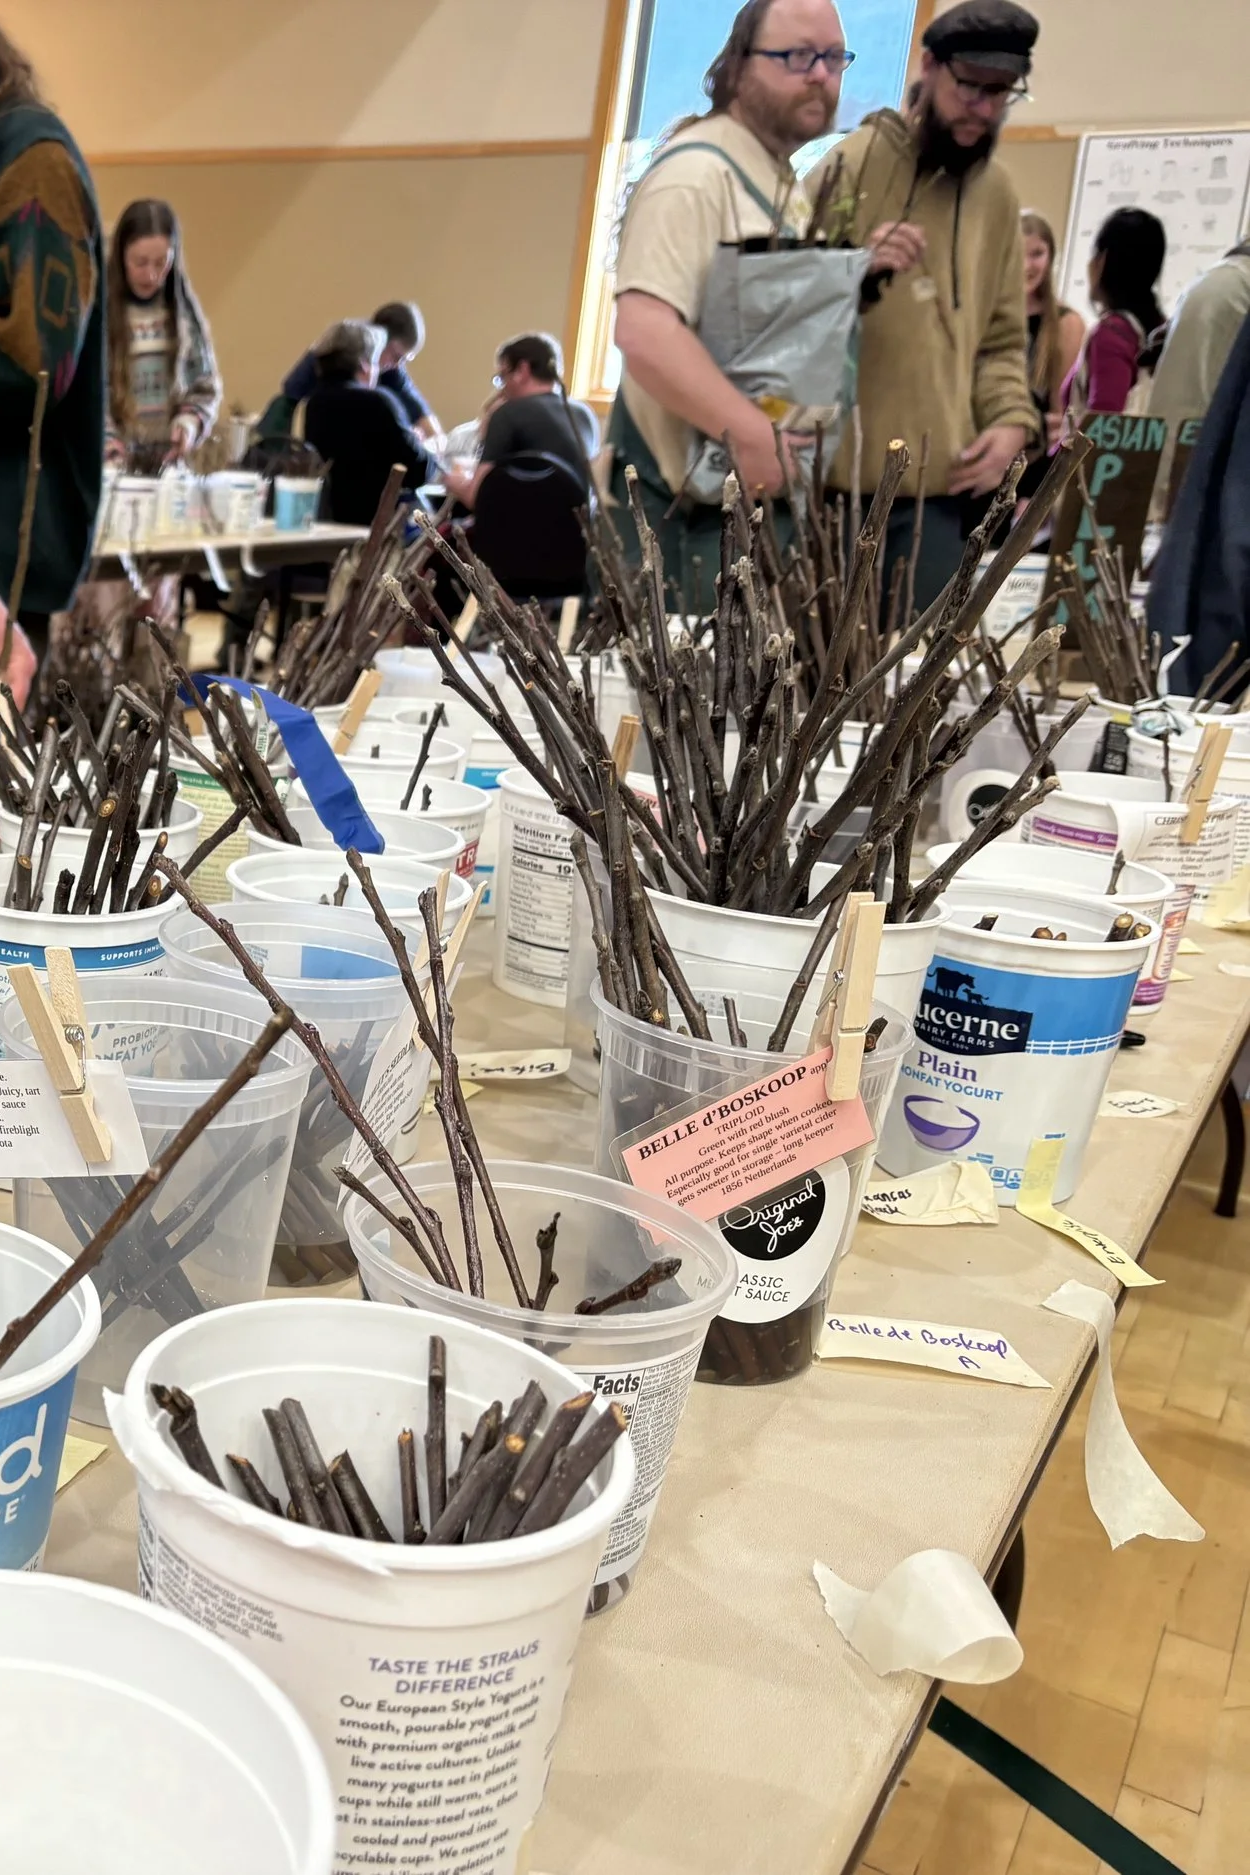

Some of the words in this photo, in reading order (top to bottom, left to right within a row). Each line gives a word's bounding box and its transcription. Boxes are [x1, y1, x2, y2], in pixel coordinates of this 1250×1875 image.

[1163, 138, 1233, 149] Techniques
[1086, 416, 1168, 451] ASIAN
[513, 824, 551, 841] Nutrition
[512, 856, 543, 871] Calories
[101, 950, 142, 961] SUPPORTS
[917, 1003, 1020, 1041] ucerne
[951, 1032, 995, 1049] FARMS
[917, 1051, 978, 1083] Plain
[1, 1100, 26, 1109] sauce
[25, 1087, 40, 1096] tart
[945, 1081, 1004, 1102] YOGURT
[0, 1125, 39, 1136] fireblight
[698, 1139, 726, 1156] Green
[727, 1128, 748, 1143] with
[749, 1119, 764, 1133] red
[765, 1106, 790, 1126] blush
[714, 1105, 765, 1135] TRIPLOID
[637, 1120, 699, 1161] BELLE
[664, 1173, 678, 1188] All
[680, 1156, 717, 1183] purpose.
[718, 1141, 747, 1160] Keeps
[748, 1128, 773, 1150] shape
[774, 1116, 799, 1133] when
[800, 1100, 833, 1119] cooked
[667, 1169, 711, 1199] Especially
[713, 1156, 735, 1178] good
[737, 1151, 751, 1165] for
[752, 1138, 779, 1158] single
[780, 1121, 814, 1142] varietal
[815, 1109, 837, 1125] cider
[677, 1192, 695, 1207] gets
[696, 1175, 729, 1197] sweeter
[731, 1168, 740, 1178] in
[742, 1154, 774, 1177] storage
[783, 1138, 804, 1154] long
[804, 1122, 834, 1145] keeper
[721, 1180, 744, 1196] 1856
[745, 1153, 797, 1185] Netherlands
[724, 1178, 817, 1230] Original
[740, 1274, 783, 1288] ASSIC
[745, 1289, 790, 1302] SAUCE
[922, 1329, 1008, 1359] Boskoop
[959, 1356, 981, 1369] A
[593, 1373, 641, 1395] Facts
[368, 1657, 429, 1675] TASTE
[435, 1658, 473, 1674] THE
[478, 1639, 540, 1670] STRAUS
[395, 1666, 515, 1694] DIFFERENCE
[339, 1717, 400, 1734] smooth,
[404, 1720, 467, 1737] pourable
[469, 1709, 509, 1731] yogurt
[512, 1695, 539, 1714] made
[340, 1695, 371, 1710] Our
[376, 1700, 446, 1718] European
[451, 1697, 486, 1714] Style
[490, 1686, 527, 1705] Yogurt
[335, 1735, 367, 1749] with
[372, 1740, 438, 1755] premium
[442, 1734, 488, 1752] organic
[491, 1723, 516, 1740] milk
[518, 1710, 537, 1730] and
